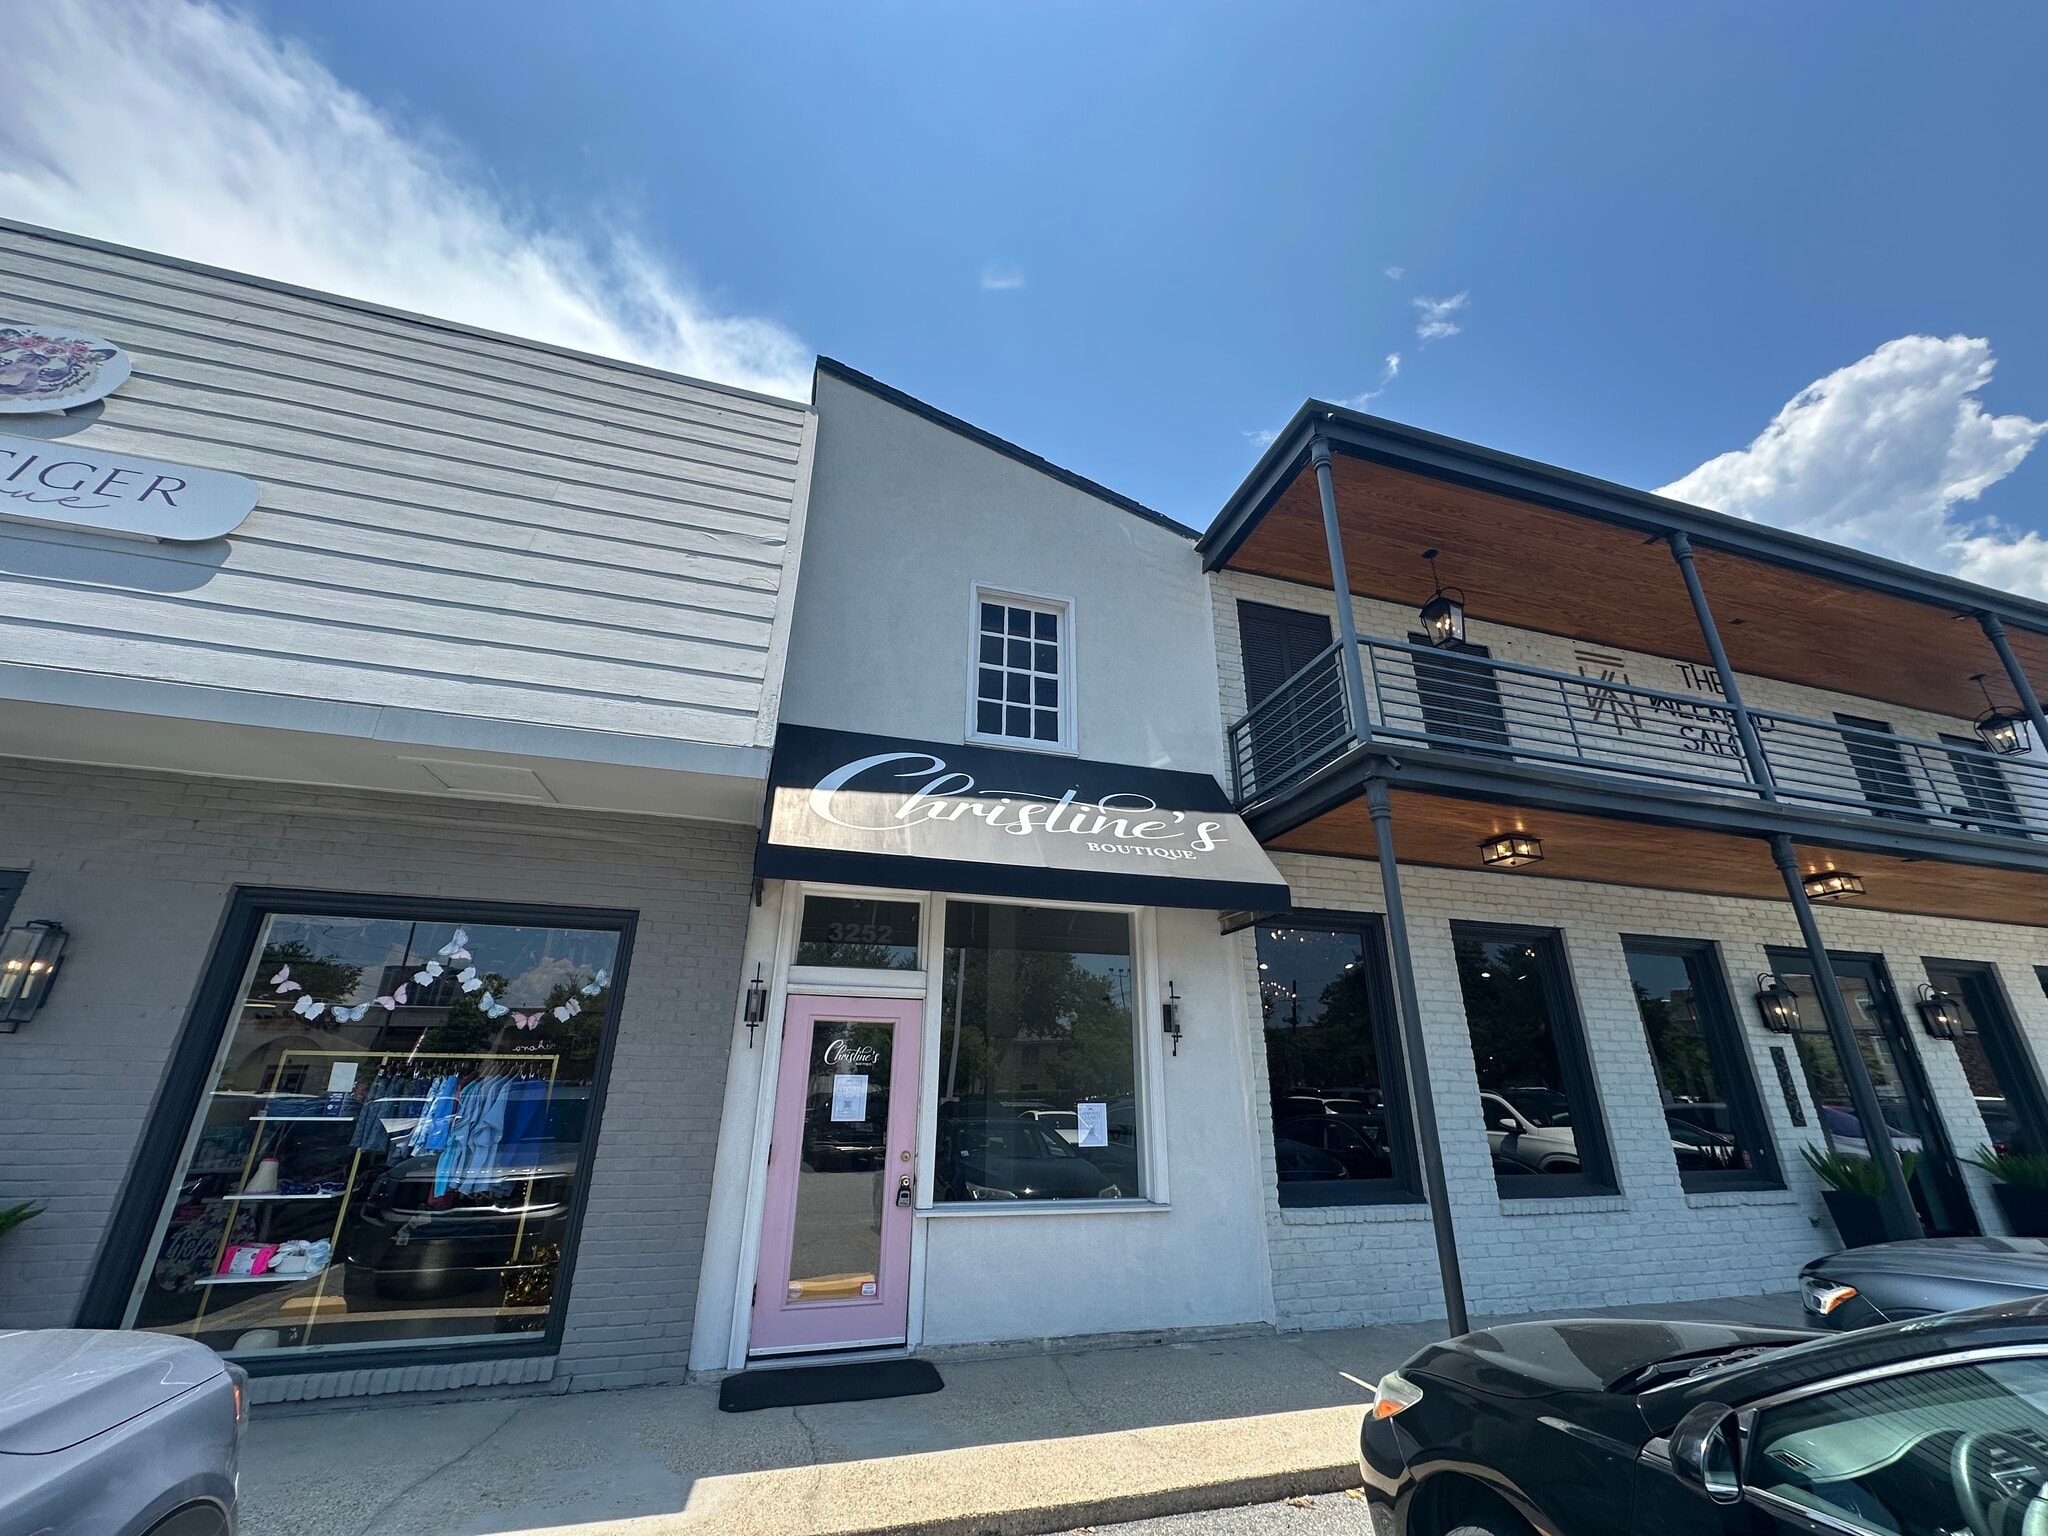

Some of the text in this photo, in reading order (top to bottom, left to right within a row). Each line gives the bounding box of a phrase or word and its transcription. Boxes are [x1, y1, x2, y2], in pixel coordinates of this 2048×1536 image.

[809, 752, 1228, 852] Christine's
[1086, 842, 1197, 860] BOUTIQUE
[828, 922, 893, 944] 3252
[824, 1039, 880, 1065] Christine's
